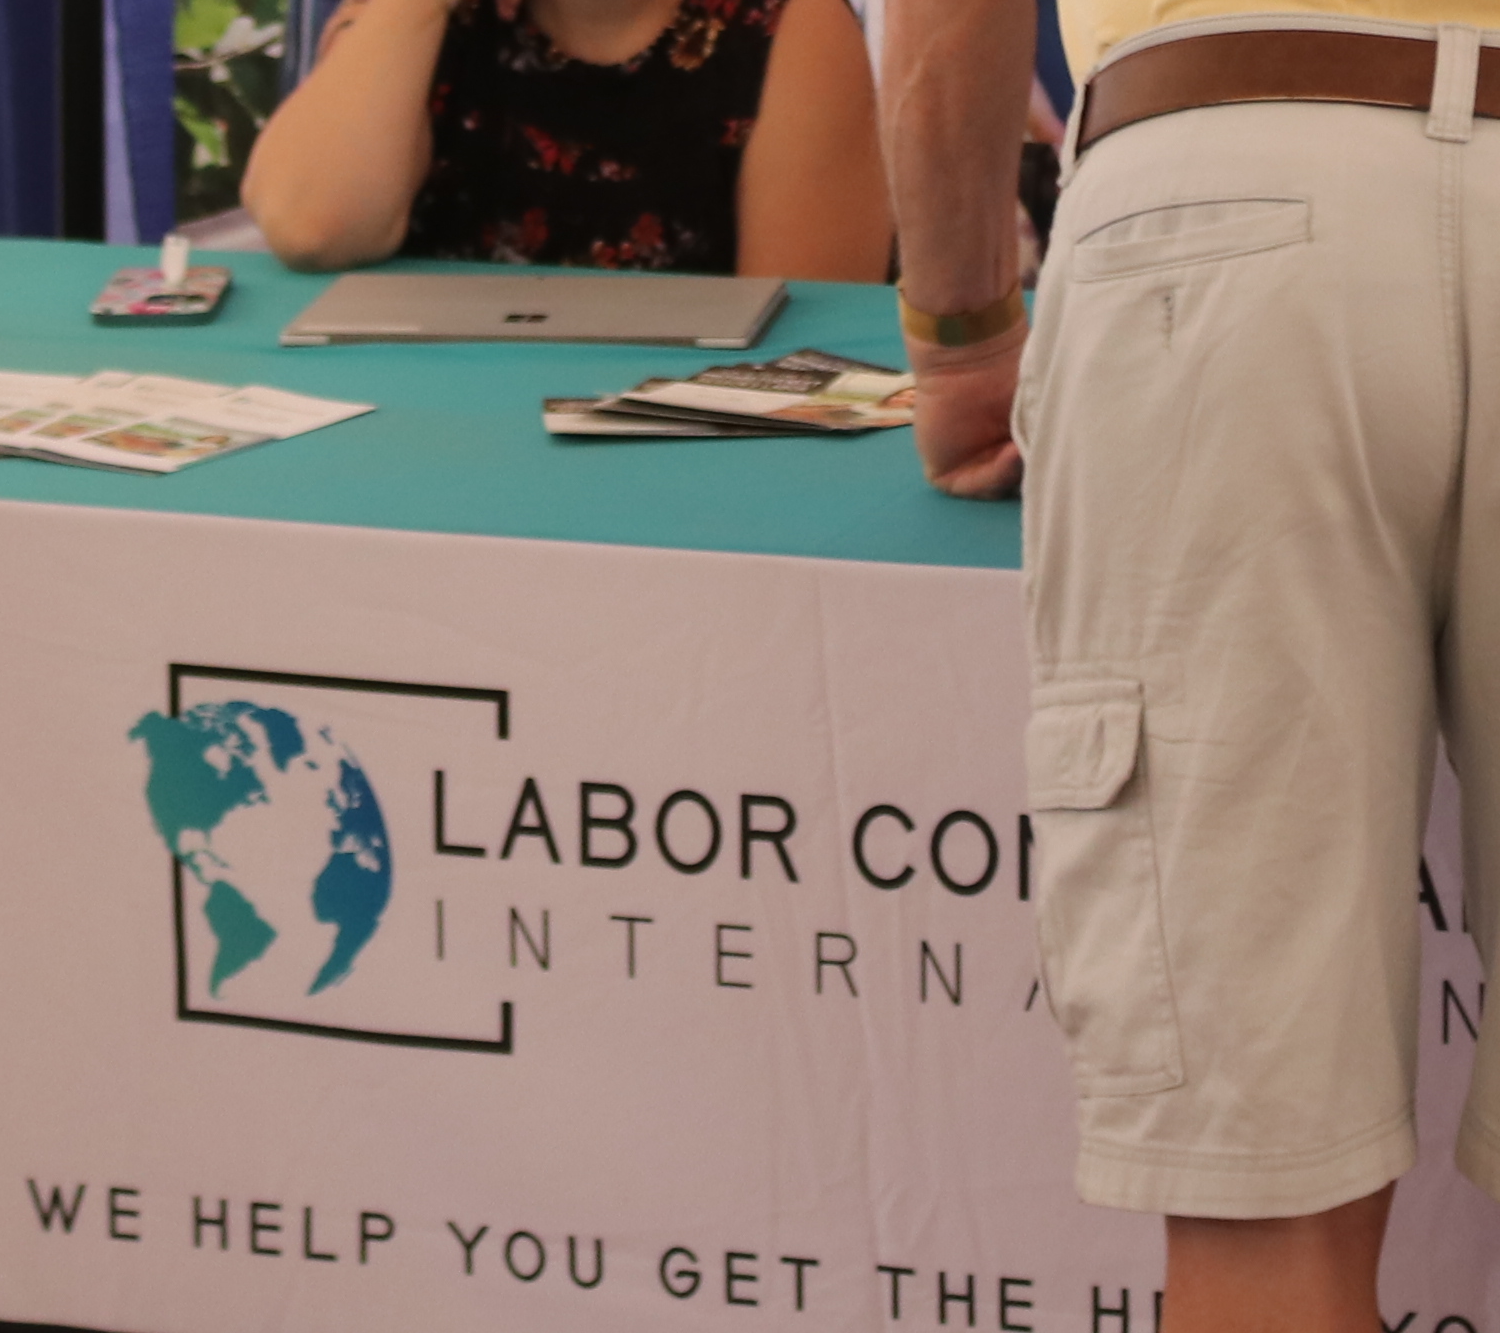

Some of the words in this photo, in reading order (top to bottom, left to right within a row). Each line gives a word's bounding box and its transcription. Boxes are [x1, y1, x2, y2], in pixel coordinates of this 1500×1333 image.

[432, 768, 801, 885] LABOR
[25, 1178, 142, 1243] WE
[191, 1195, 397, 1265] HELP
[445, 1221, 605, 1291] YOU
[657, 1244, 821, 1313] GET
[874, 1263, 1035, 1332] THE
